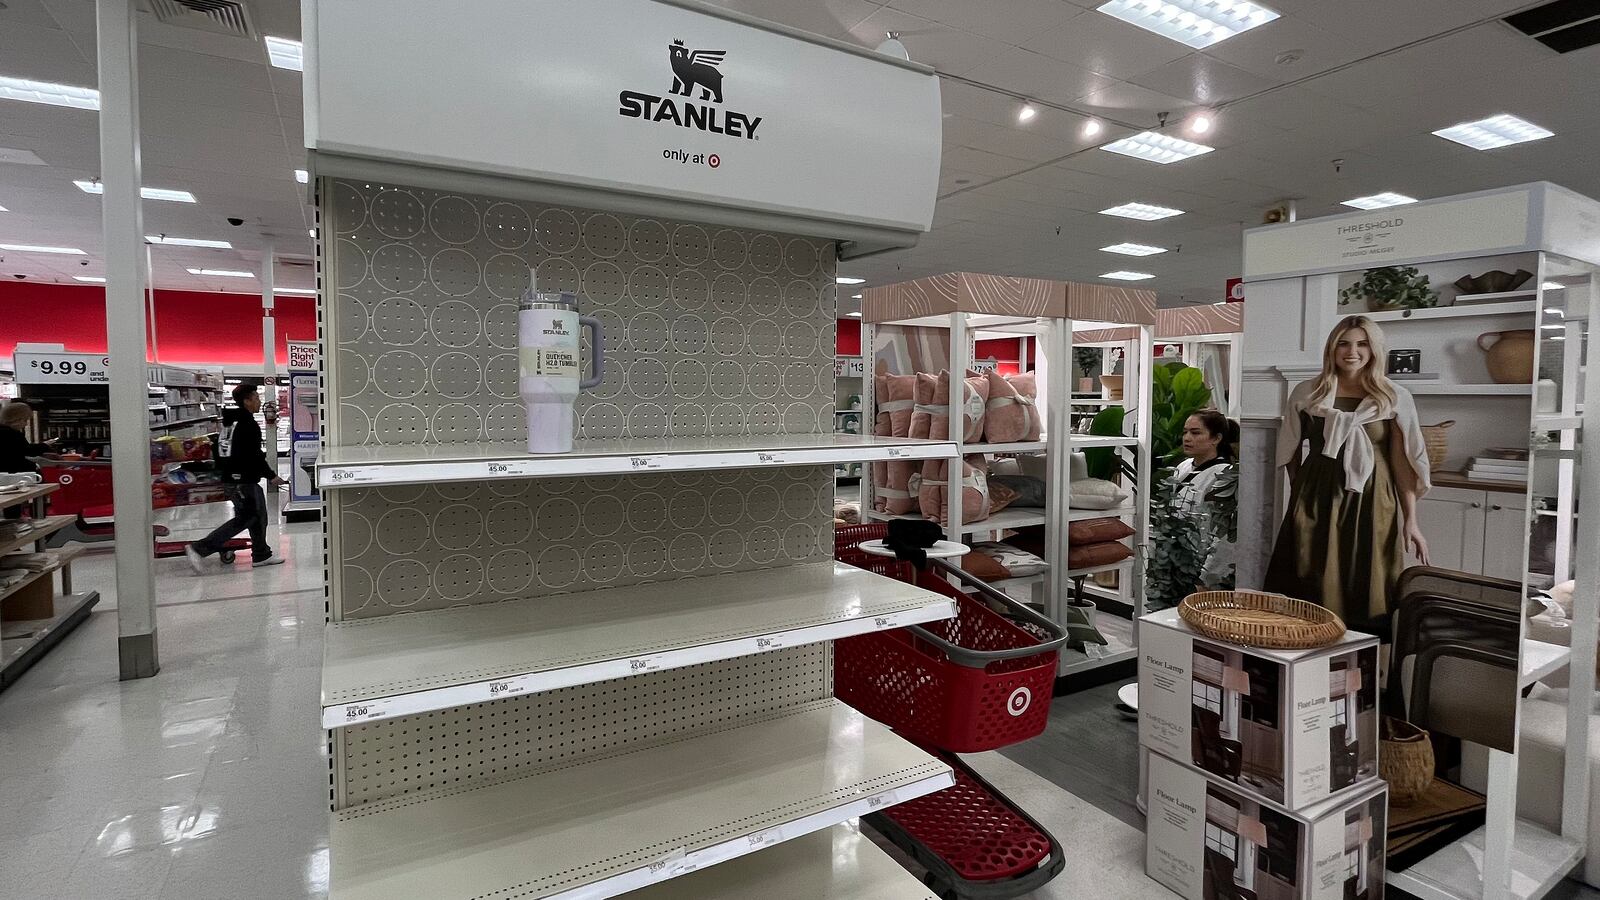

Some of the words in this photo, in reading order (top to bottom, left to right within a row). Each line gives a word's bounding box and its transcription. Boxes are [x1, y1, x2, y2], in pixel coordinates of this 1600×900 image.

[619, 90, 762, 140] STANLEY
[662, 149, 690, 164] only
[692, 153, 705, 164] at
[1337, 218, 1403, 234] THRESHOLD
[290, 353, 314, 361] Right
[290, 360, 313, 368] Daily
[488, 465, 507, 473] 45.00
[332, 472, 353, 480] 45.00
[630, 661, 647, 670] 45.00
[1146, 655, 1164, 668] Floor
[1164, 662, 1185, 675] Lamp
[489, 684, 509, 693] 45.00
[1297, 700, 1311, 711] Floor
[1311, 697, 1327, 706] Lamp
[346, 708, 368, 718] 45.00
[1156, 788, 1175, 803] Floor
[1175, 797, 1198, 814] Lamp
